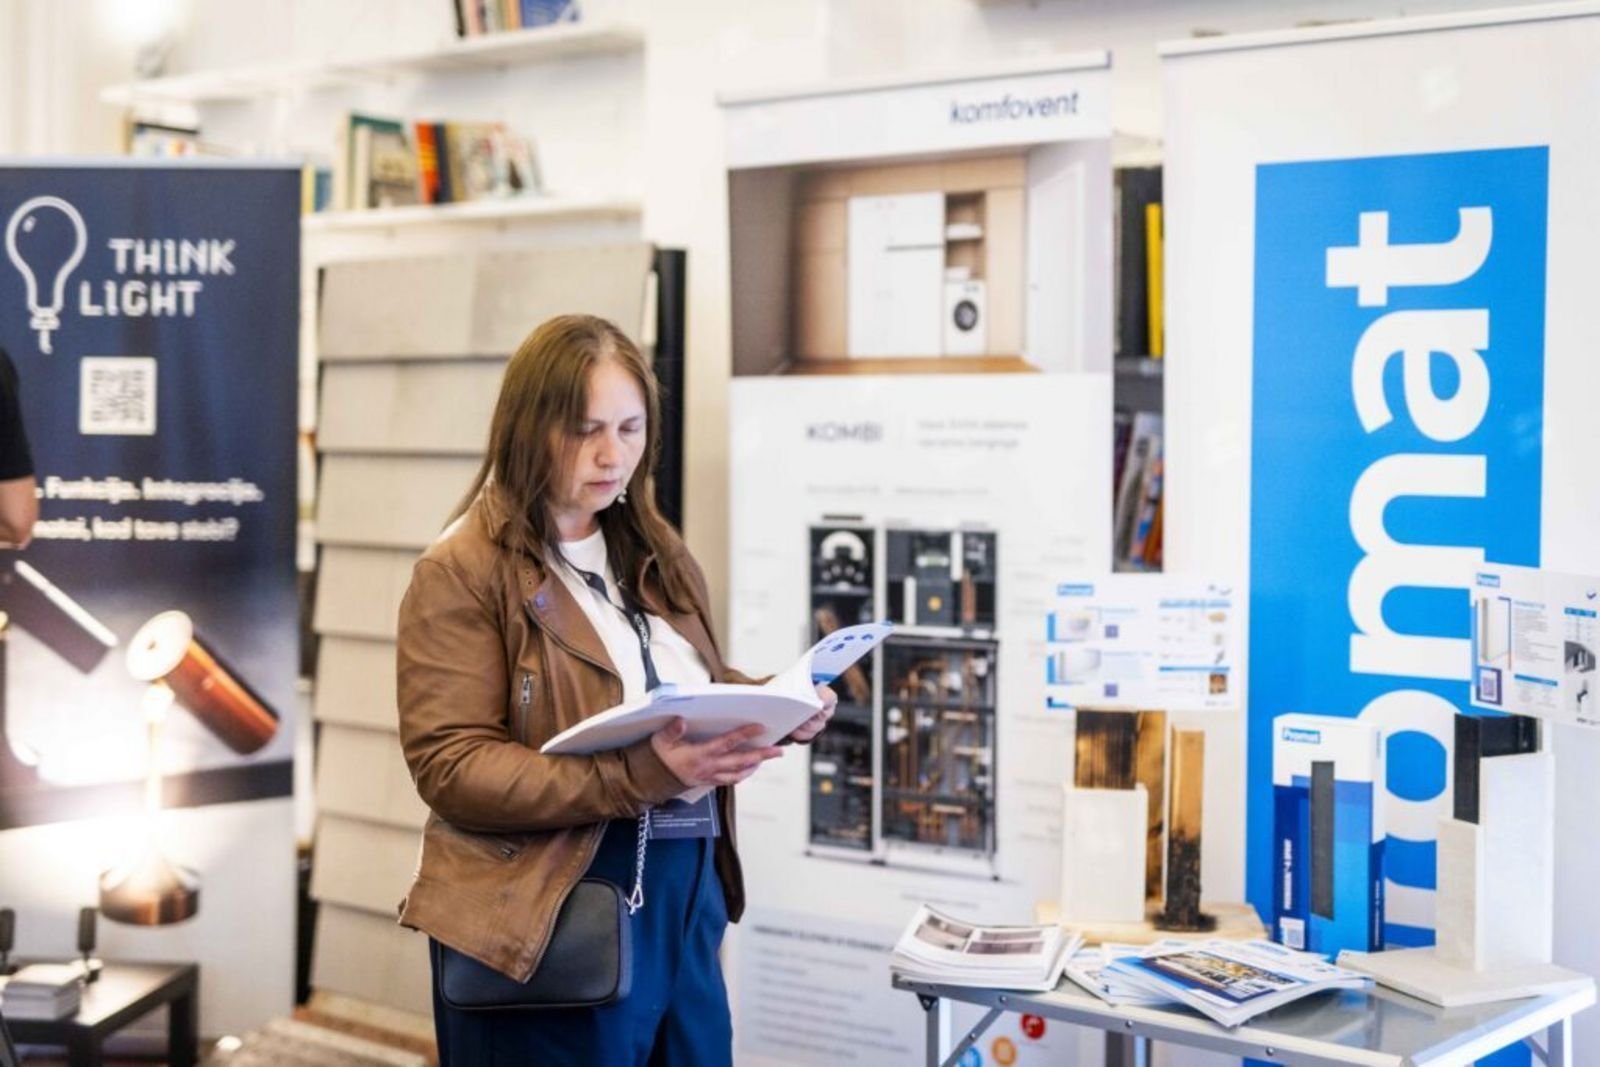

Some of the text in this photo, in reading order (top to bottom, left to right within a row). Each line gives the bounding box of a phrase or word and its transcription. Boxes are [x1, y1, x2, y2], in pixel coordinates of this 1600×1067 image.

[950, 91, 1079, 124] komfovent
[108, 238, 236, 275] THINK
[80, 280, 203, 316] LIGHT
[806, 421, 883, 443] KOMBI
[1325, 205, 1493, 930] omat
[1283, 728, 1320, 744] Promat
